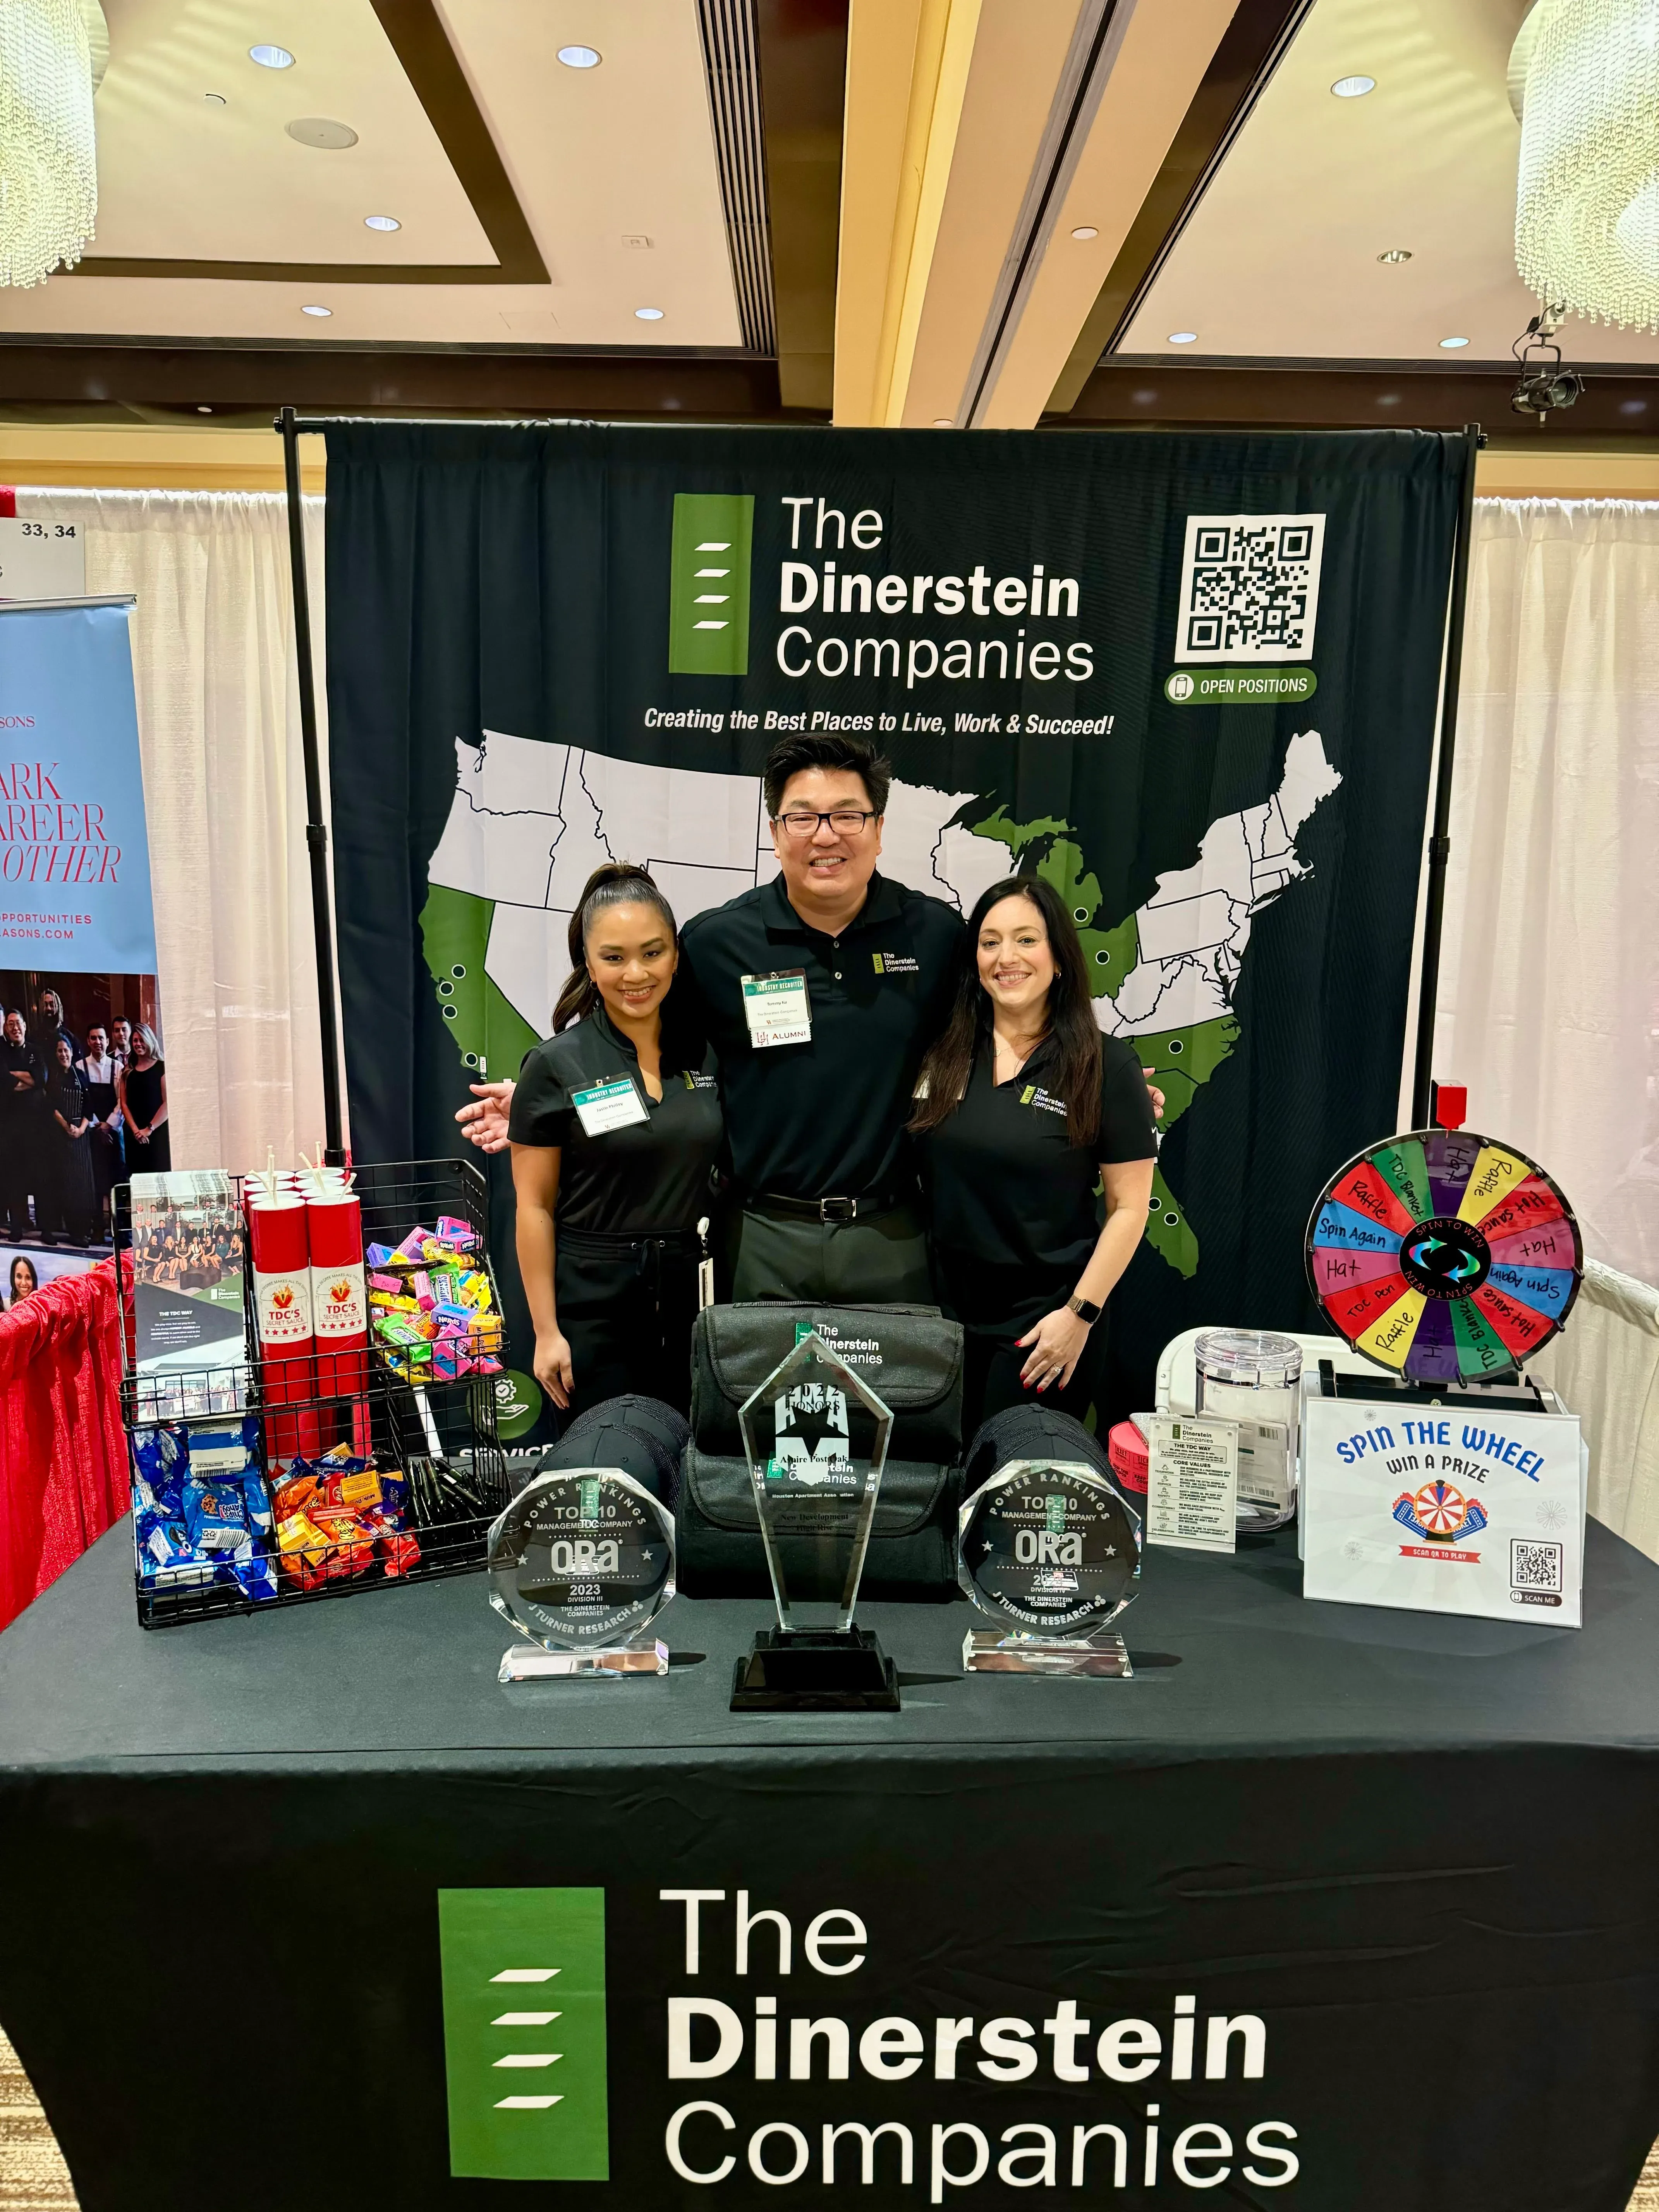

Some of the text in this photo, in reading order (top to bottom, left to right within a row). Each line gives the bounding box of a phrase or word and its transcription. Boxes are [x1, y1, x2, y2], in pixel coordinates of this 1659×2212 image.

[22, 523, 76, 539] 33, 34
[781, 497, 883, 550] The
[780, 561, 1080, 617] Dinerstein
[776, 625, 1094, 689] Companies
[1200, 678, 1308, 694] OPEN POSITIONS
[644, 708, 1114, 736] Creating the Best Places to Live, Work & Succeed!
[0, 803, 108, 842] REER
[0, 913, 92, 924] PPORTUNITIES
[0, 928, 74, 939] ASONS.COM
[884, 957, 916, 965] Dinerstein
[757, 981, 803, 992] INDUSTRY RECRUITER
[772, 1030, 806, 1040] ALUMNI
[1037, 1087, 1049, 1096] The
[1031, 1099, 1068, 1116] Companies
[1446, 1146, 1470, 1183] Hat
[1388, 1154, 1424, 1218] TDC Blanket
[1474, 1158, 1512, 1197] Raffle
[1348, 1180, 1388, 1219] Raffle
[1319, 1218, 1386, 1248] Spin Again
[1416, 1220, 1485, 1248] SPIN TO WIN
[1520, 1236, 1556, 1257] Hat
[1327, 1259, 1362, 1280] Hat
[1405, 1270, 1473, 1298] SPIN TO WIN
[1491, 1267, 1560, 1299] Spin Again
[326, 1302, 357, 1314] TDC'S
[1346, 1284, 1396, 1317] TDC Pen
[268, 1309, 300, 1321] TDC'S
[286, 1316, 304, 1324] SAUCE
[437, 1316, 460, 1326] Nerds
[1510, 1312, 1536, 1338] Hot
[817, 1324, 838, 1336] The
[1375, 1312, 1414, 1353] Raffle
[819, 1337, 879, 1351] inerstein
[1423, 1325, 1443, 1358] Hat
[1476, 1343, 1498, 1370] TDC
[787, 1400, 840, 1411] HONORS
[1182, 1430, 1212, 1438] Dinerstein
[810, 1455, 827, 1463] Post
[1336, 1421, 1545, 1483] SPIN THE WHEEL
[1386, 1454, 1490, 1484] WIN A PRIZE
[524, 1483, 646, 1528] POWER RNKINGS
[989, 1473, 1110, 1520] POWER RANKINGS
[1021, 1496, 1055, 1510] TOP
[225, 1509, 244, 1519] Chips
[554, 1505, 617, 1519] TOP 10
[799, 1513, 848, 1522] Development
[1058, 1513, 1097, 1521] COMPANY
[536, 1522, 592, 1530] MANAGEME
[570, 1584, 601, 1596] 2023
[1524, 1595, 1544, 1603] SCAN
[535, 1609, 575, 1634] TURNER
[579, 1607, 632, 1635] RESEARCH
[999, 1596, 1038, 1625] TURNER
[1041, 1602, 1094, 1626] RESEARCH
[660, 1889, 868, 1976] The
[667, 1995, 1266, 2081] Dinerstein
[665, 2100, 1300, 2204] Companies
